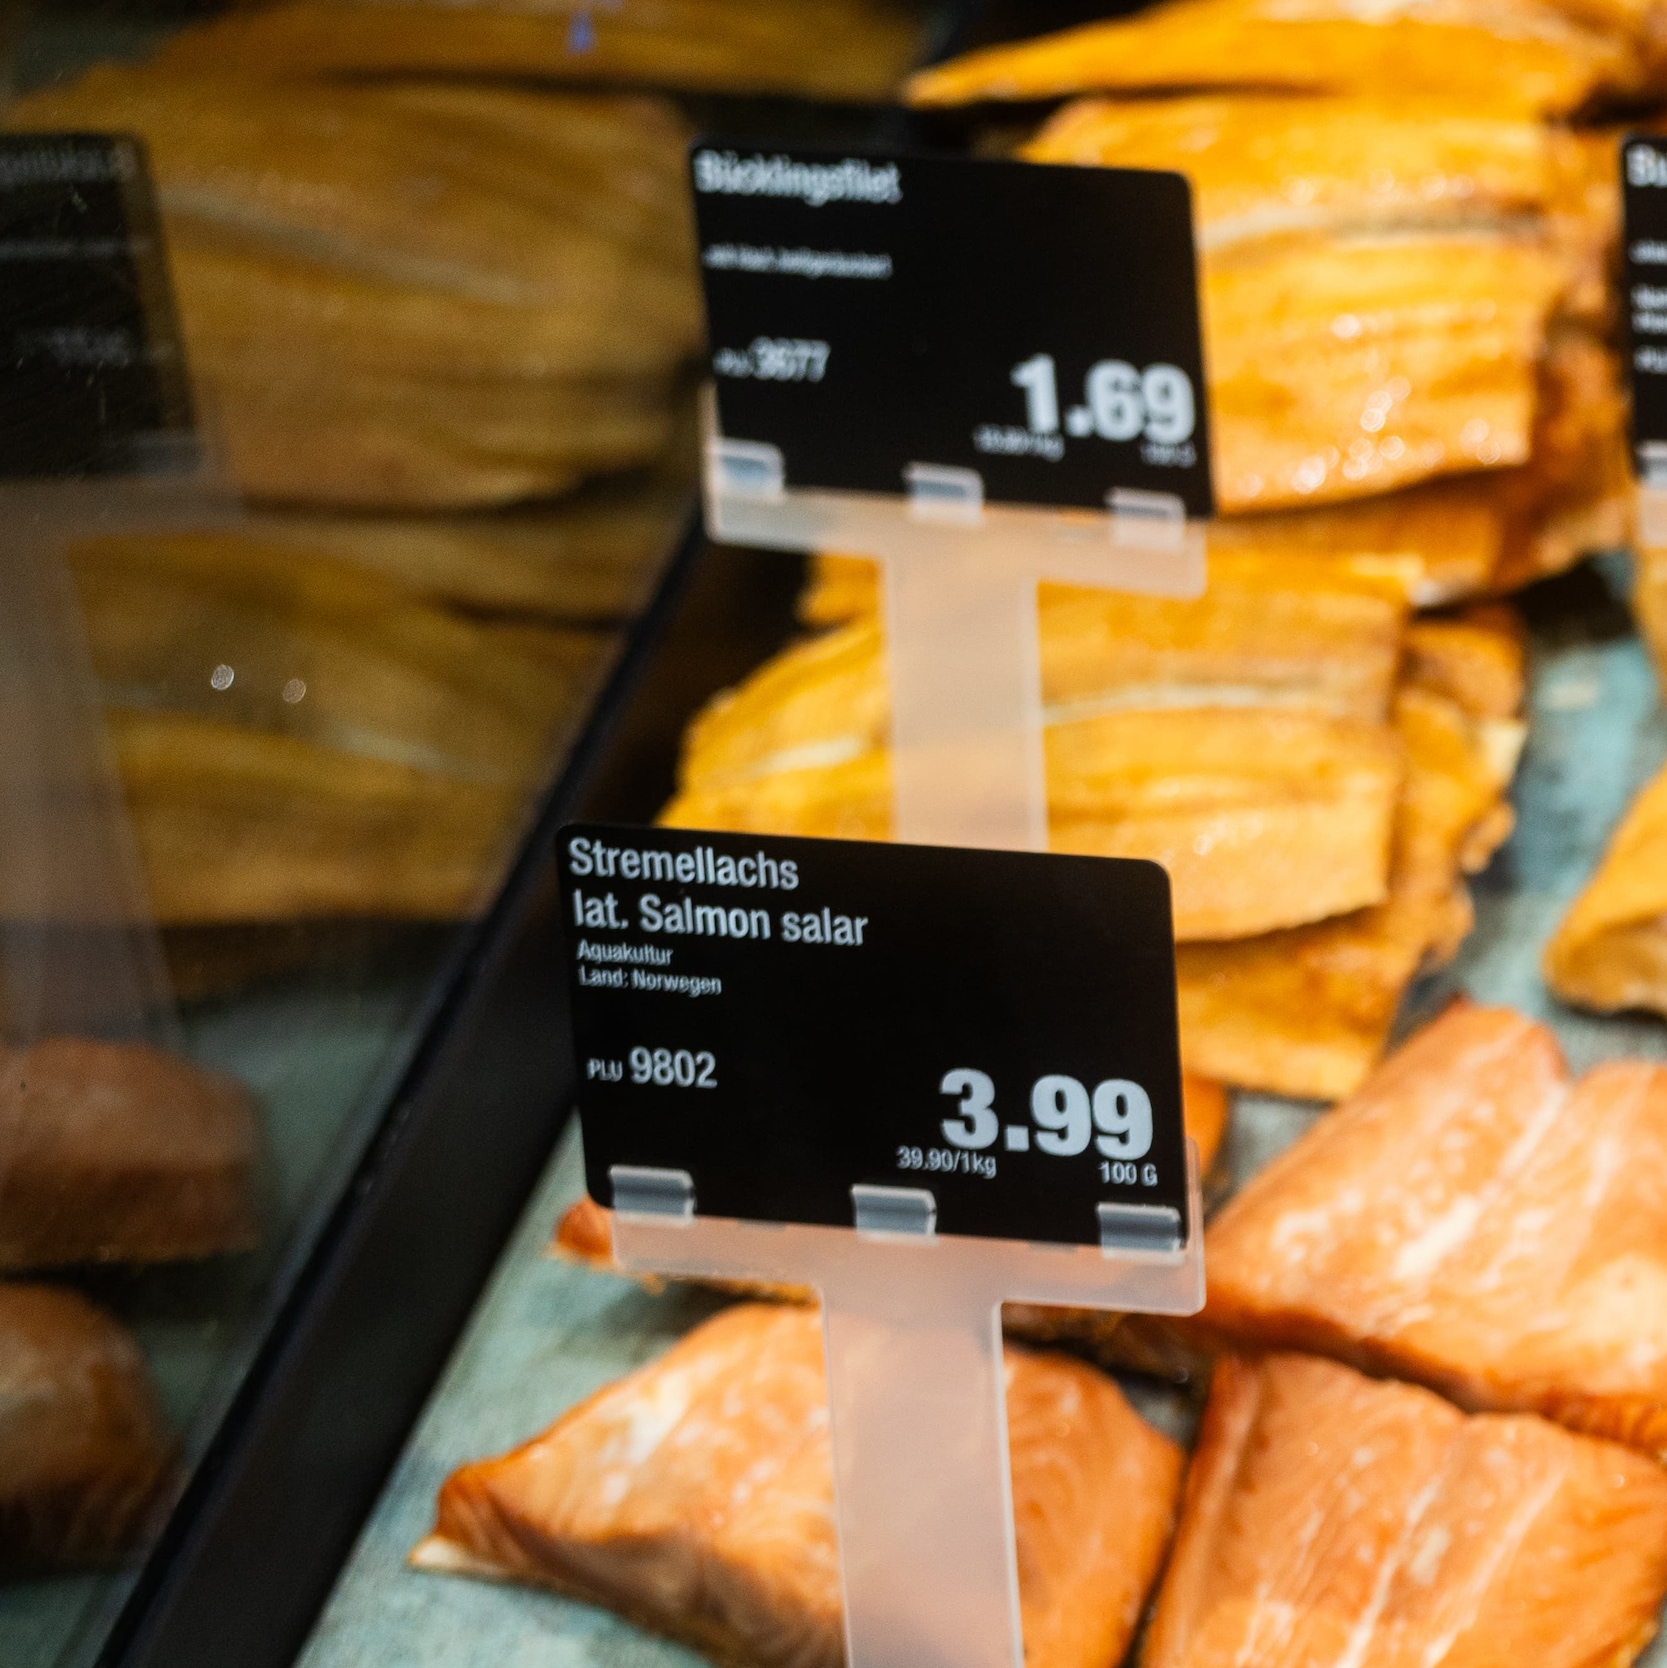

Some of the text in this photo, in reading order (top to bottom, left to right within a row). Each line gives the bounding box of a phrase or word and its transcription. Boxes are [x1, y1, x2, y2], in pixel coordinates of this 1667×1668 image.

[1010, 355, 1196, 443] 1.69
[570, 836, 800, 890] Stremellachs
[574, 889, 868, 945] lat. Salmon salar
[578, 939, 673, 966] Aquakultur
[580, 966, 722, 998] Land: Norwegen
[589, 1047, 718, 1089] PLU 9802
[939, 1067, 1153, 1161] 3.99
[898, 1145, 997, 1179] 39.90/1kg
[1101, 1162, 1158, 1186] 100 G
